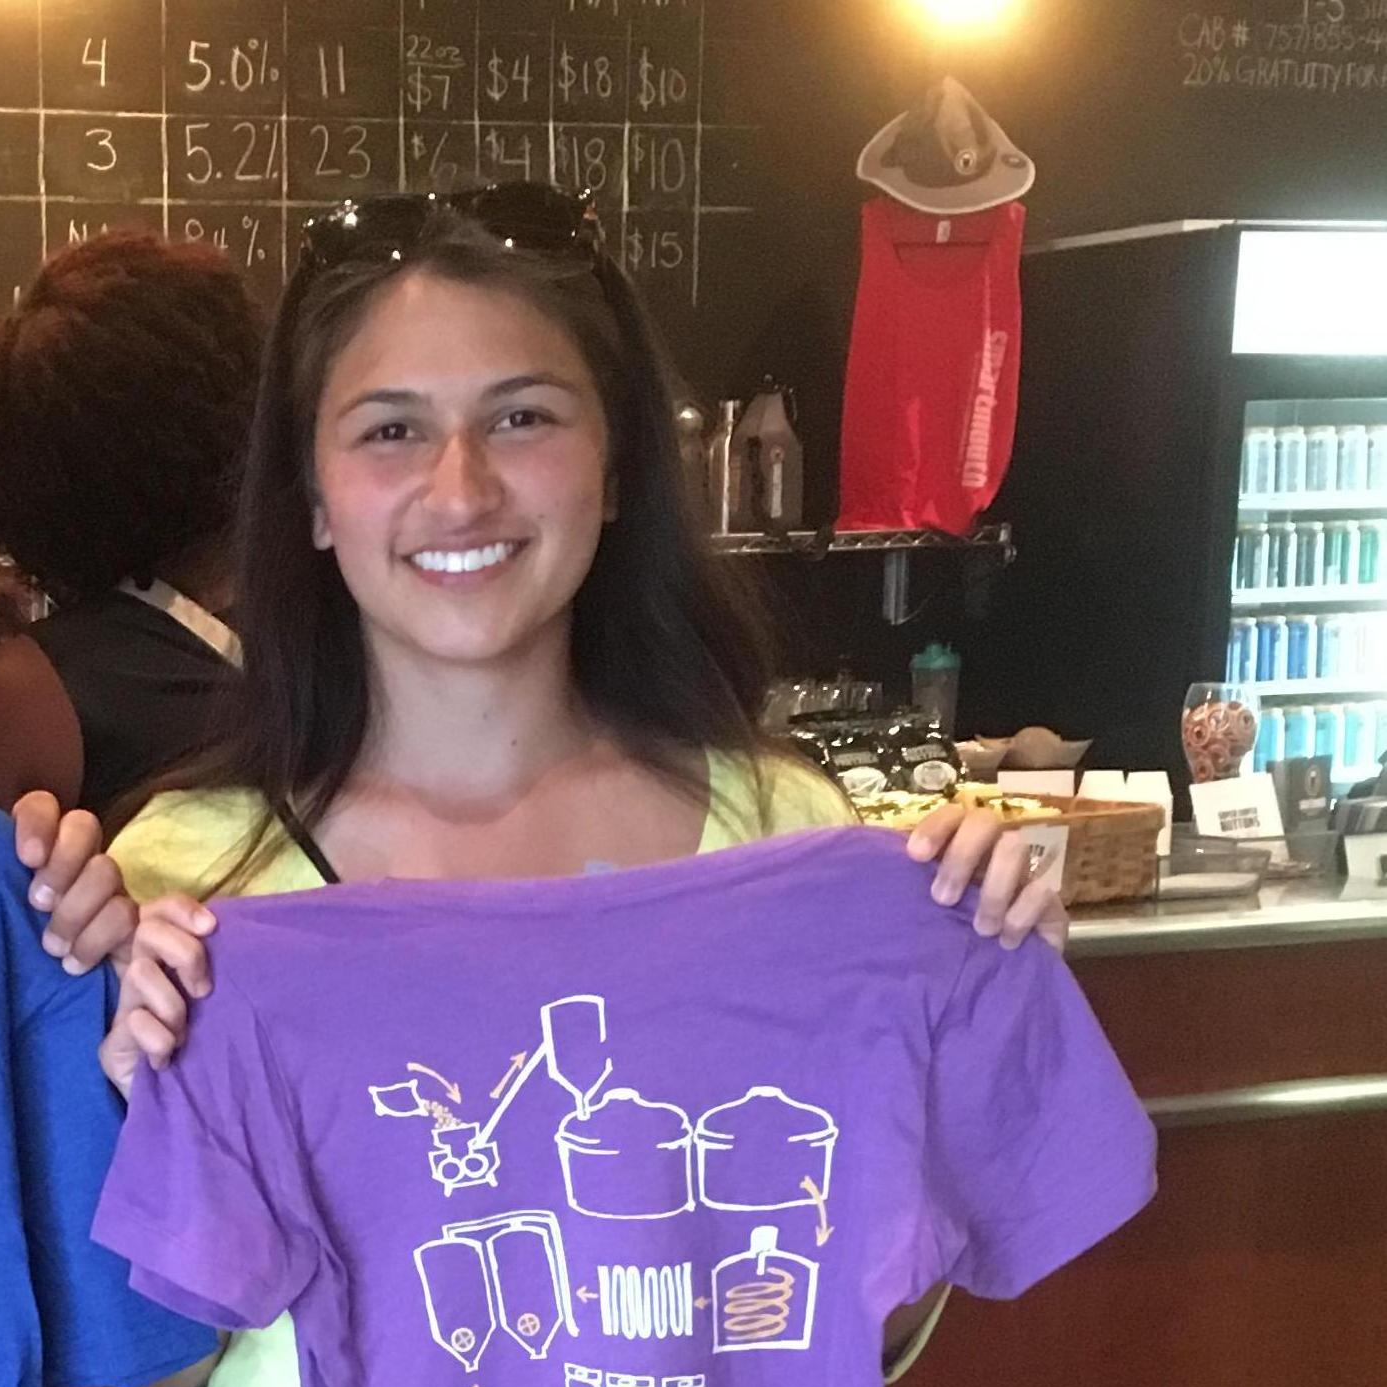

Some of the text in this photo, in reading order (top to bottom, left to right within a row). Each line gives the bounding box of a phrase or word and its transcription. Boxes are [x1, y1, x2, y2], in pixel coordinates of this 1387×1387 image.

[1179, 12, 1225, 51] CAB
[81, 37, 106, 87] 4
[184, 39, 280, 93] 5.0%
[318, 45, 345, 98] 11
[407, 42, 687, 113] $7 $4 $18 $10
[1183, 53, 1231, 86] 20%
[1235, 55, 1344, 93] GRATUITY
[85, 128, 117, 171] 3
[184, 122, 279, 184] 5.2%
[310, 124, 371, 179] 23
[630, 130, 686, 192] $10
[627, 227, 684, 270] $15
